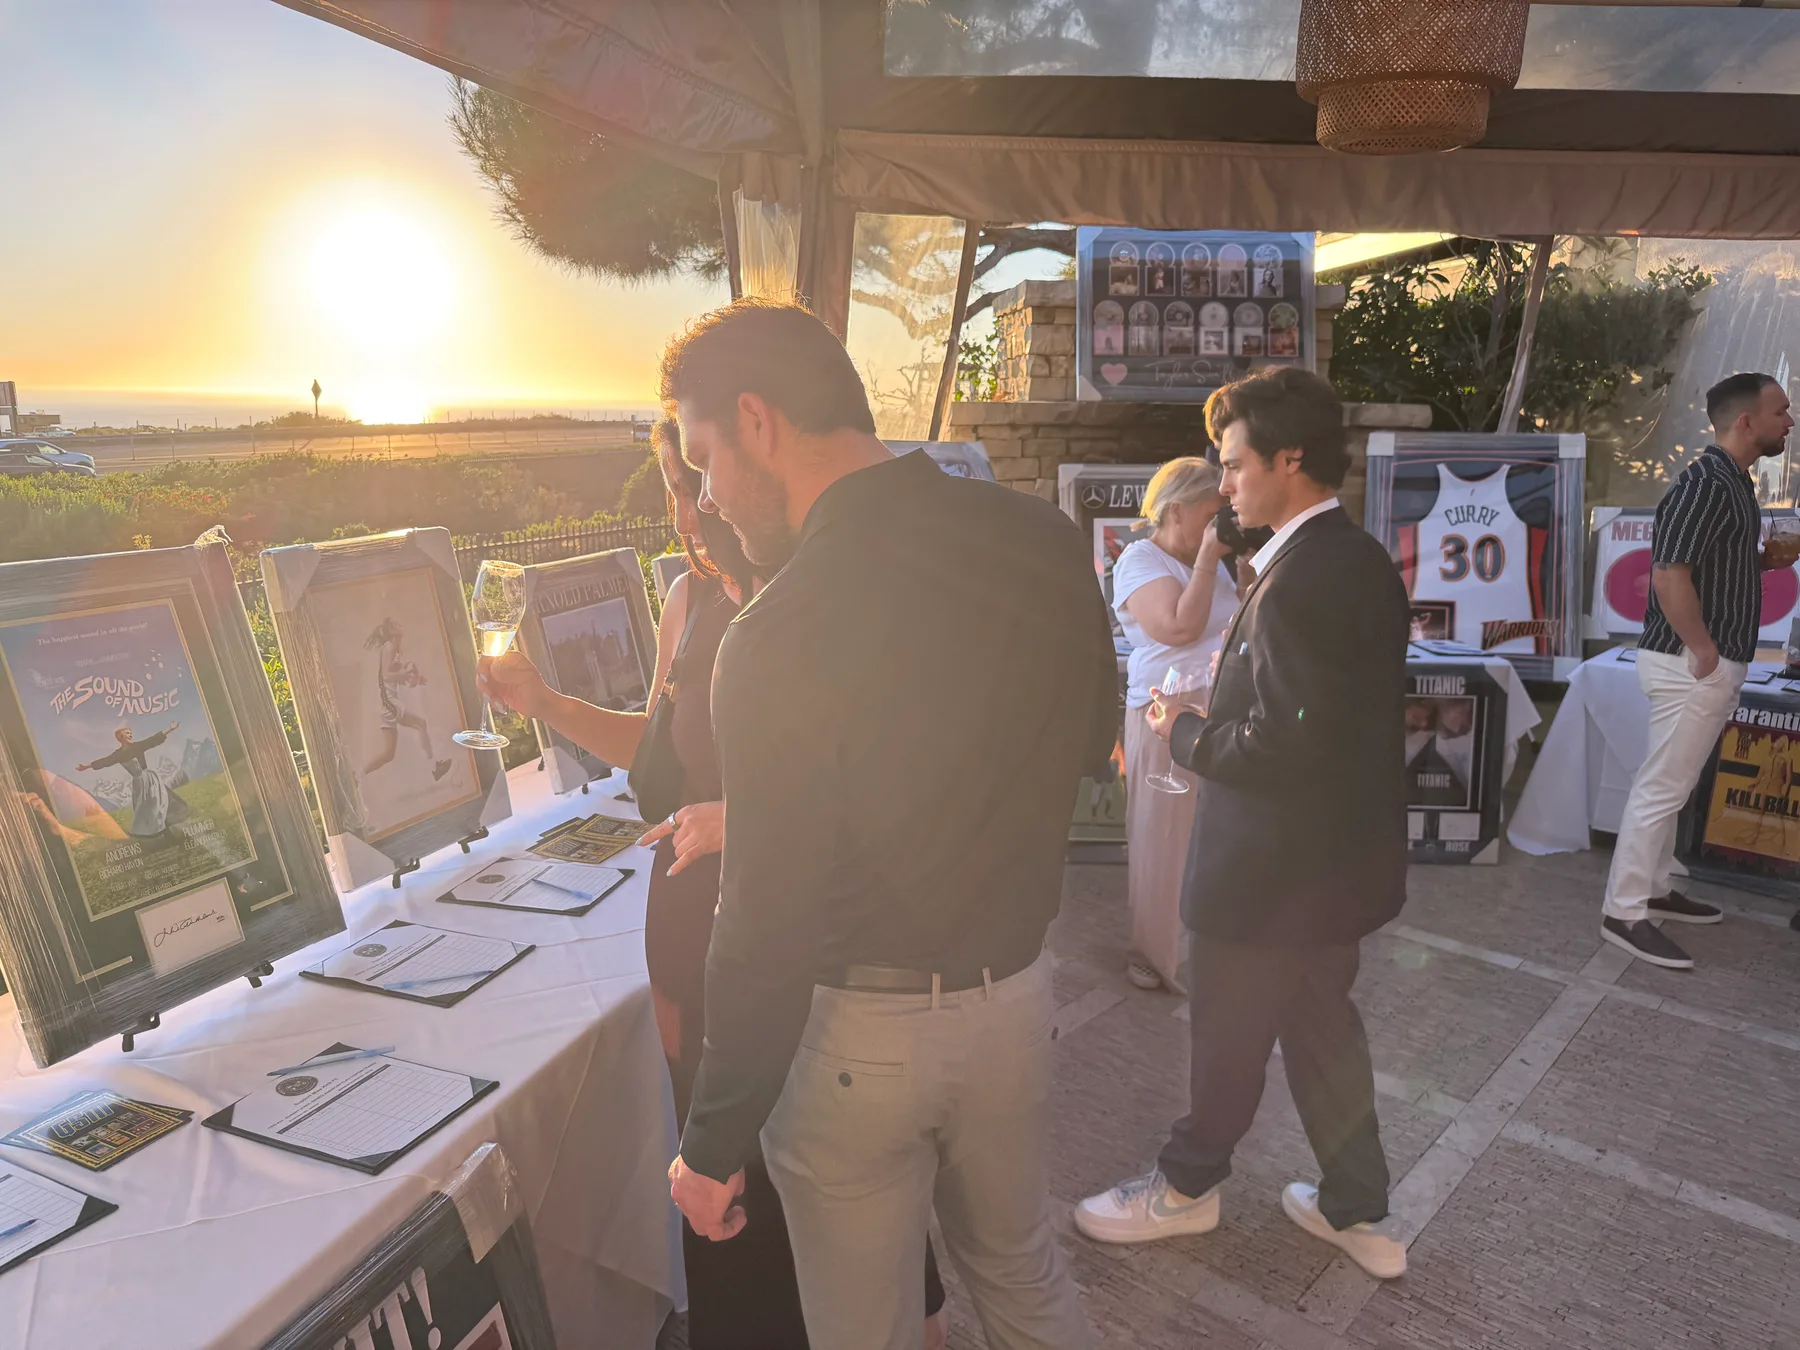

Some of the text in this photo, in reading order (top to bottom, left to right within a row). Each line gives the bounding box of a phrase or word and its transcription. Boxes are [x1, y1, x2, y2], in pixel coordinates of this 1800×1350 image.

[1444, 504, 1500, 527] CURRY
[1611, 521, 1653, 541] MEG
[1439, 533, 1506, 583] 30
[532, 585, 581, 614] RNOLD
[37, 637, 50, 646] The
[1481, 619, 1559, 651] WARRIORS
[50, 686, 75, 715] THE
[72, 675, 144, 710] SOUND
[1415, 676, 1466, 695] TITANIC
[105, 687, 180, 717] OF MUSIC
[1727, 706, 1800, 732] aranti
[1417, 773, 1450, 788] TITANIC
[1725, 787, 1763, 809] KILL
[182, 818, 216, 838] PLUMMER
[105, 843, 142, 864] ANDREWS
